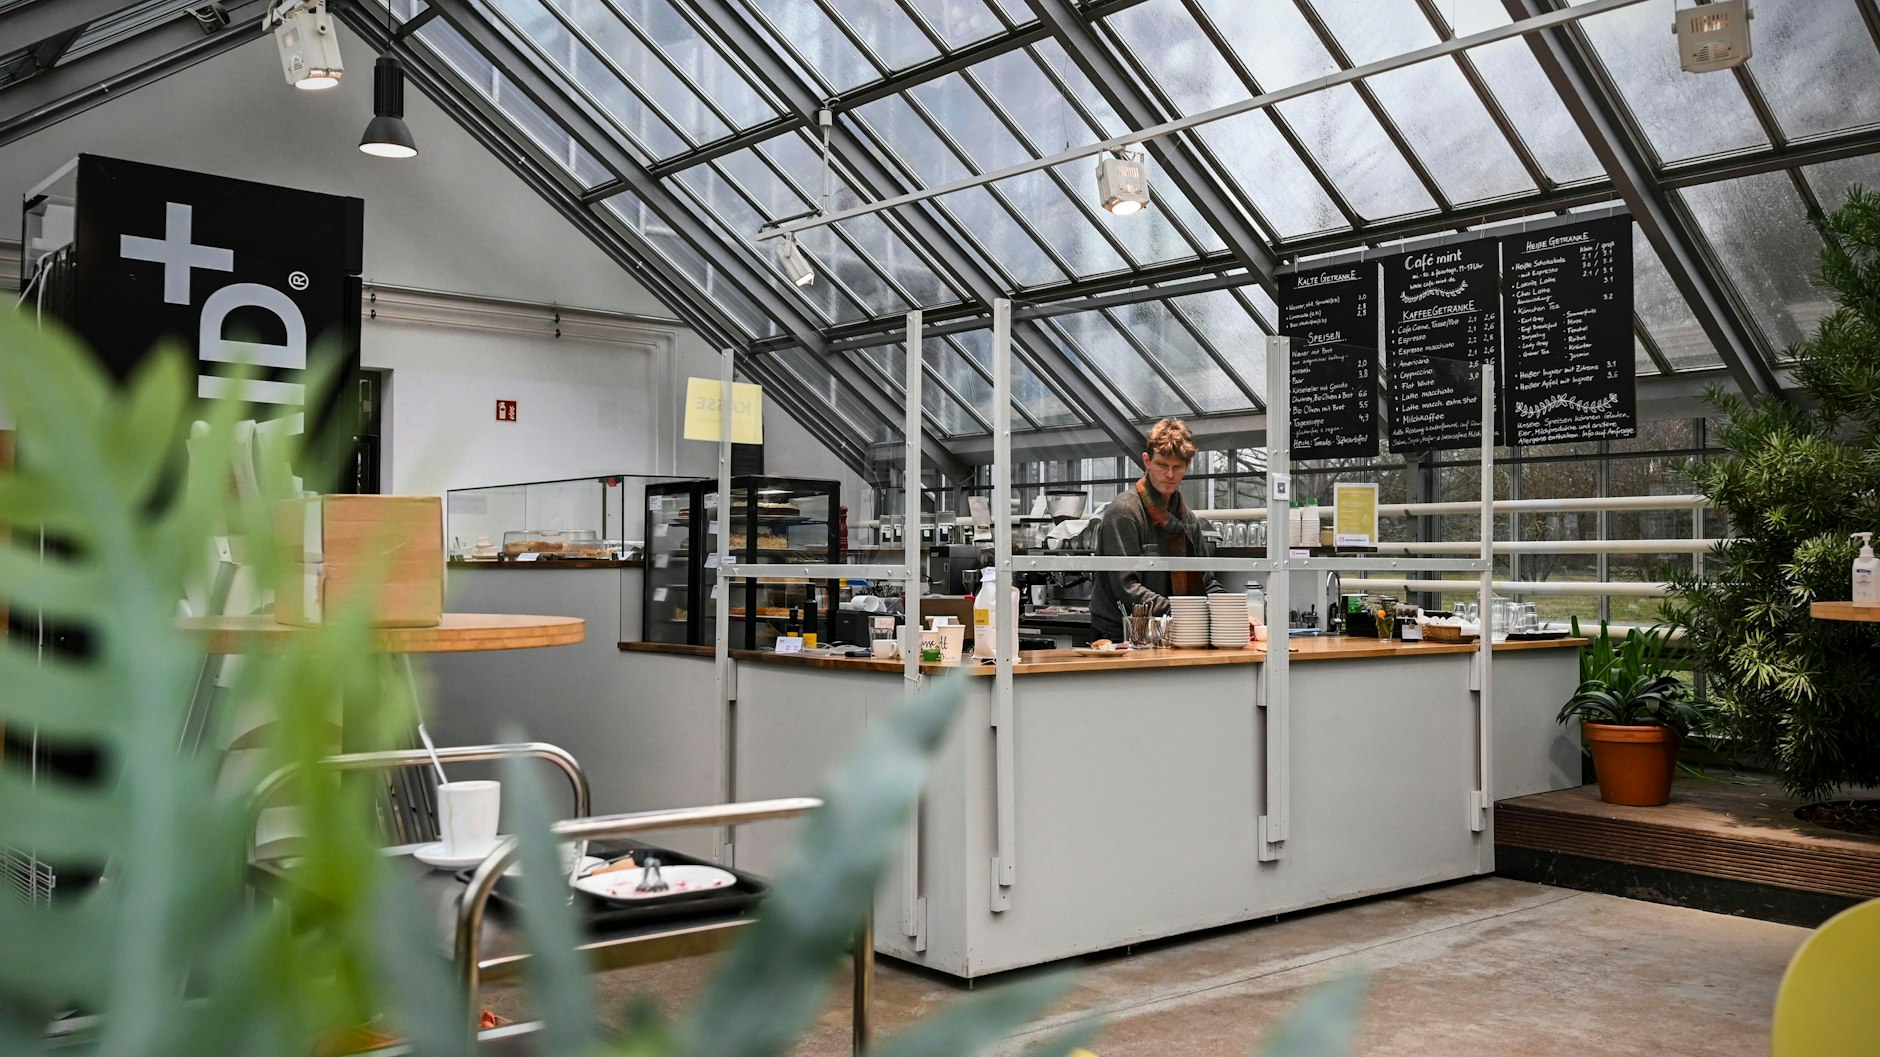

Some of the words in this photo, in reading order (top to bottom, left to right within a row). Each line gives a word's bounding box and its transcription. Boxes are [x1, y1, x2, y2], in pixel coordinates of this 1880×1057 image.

[1404, 253, 1434, 272] Café
[1436, 248, 1462, 264] mint
[1533, 256, 1566, 268] Schokolade
[1531, 267, 1558, 277] Espresso
[1297, 276, 1318, 286] KALTE
[1539, 277, 1556, 285] Latte
[1516, 290, 1531, 299] Chai
[1548, 302, 1560, 310] Tee
[1483, 312, 1495, 321] 2,6
[1307, 331, 1340, 344] SPEISEN
[1397, 334, 1427, 345] Espresso
[1483, 322, 1495, 331] 2,6
[1398, 345, 1423, 356] Espresso
[1425, 342, 1455, 351] macchiato
[1482, 333, 1494, 342] 2,8
[1522, 342, 1535, 350] Lady
[1398, 358, 1430, 368] Americano
[1483, 346, 1495, 354] 2,6
[1400, 368, 1433, 380] Cappuccino
[1542, 368, 1563, 378] Ingwer
[1564, 366, 1575, 374] mit
[1575, 364, 1599, 373] Zitrone
[1416, 379, 1435, 387] White
[1468, 372, 1479, 380] 3,0
[1519, 382, 1541, 391] Heißer
[1541, 378, 1559, 389] Apfel
[1560, 377, 1570, 385] mit
[1572, 375, 1594, 385] Ingwer
[1401, 393, 1419, 401] Latte
[1421, 387, 1454, 397] macchiato
[1292, 406, 1302, 415] Bio
[1303, 405, 1321, 414] Oliven
[1359, 400, 1369, 409] 5,5
[1401, 404, 1419, 412] Latte
[1445, 398, 1462, 406] extra
[1293, 418, 1324, 429] Tagessuppe
[1402, 413, 1445, 425] Milchkaffee
[1544, 416, 1572, 427] Speisen
[1574, 414, 1600, 422] können
[1534, 424, 1577, 436] Milchprodukte
[1578, 422, 1590, 430] und
[1582, 429, 1594, 438] Info
[1594, 430, 1606, 438] auf
[1293, 439, 1312, 448] Heute:
